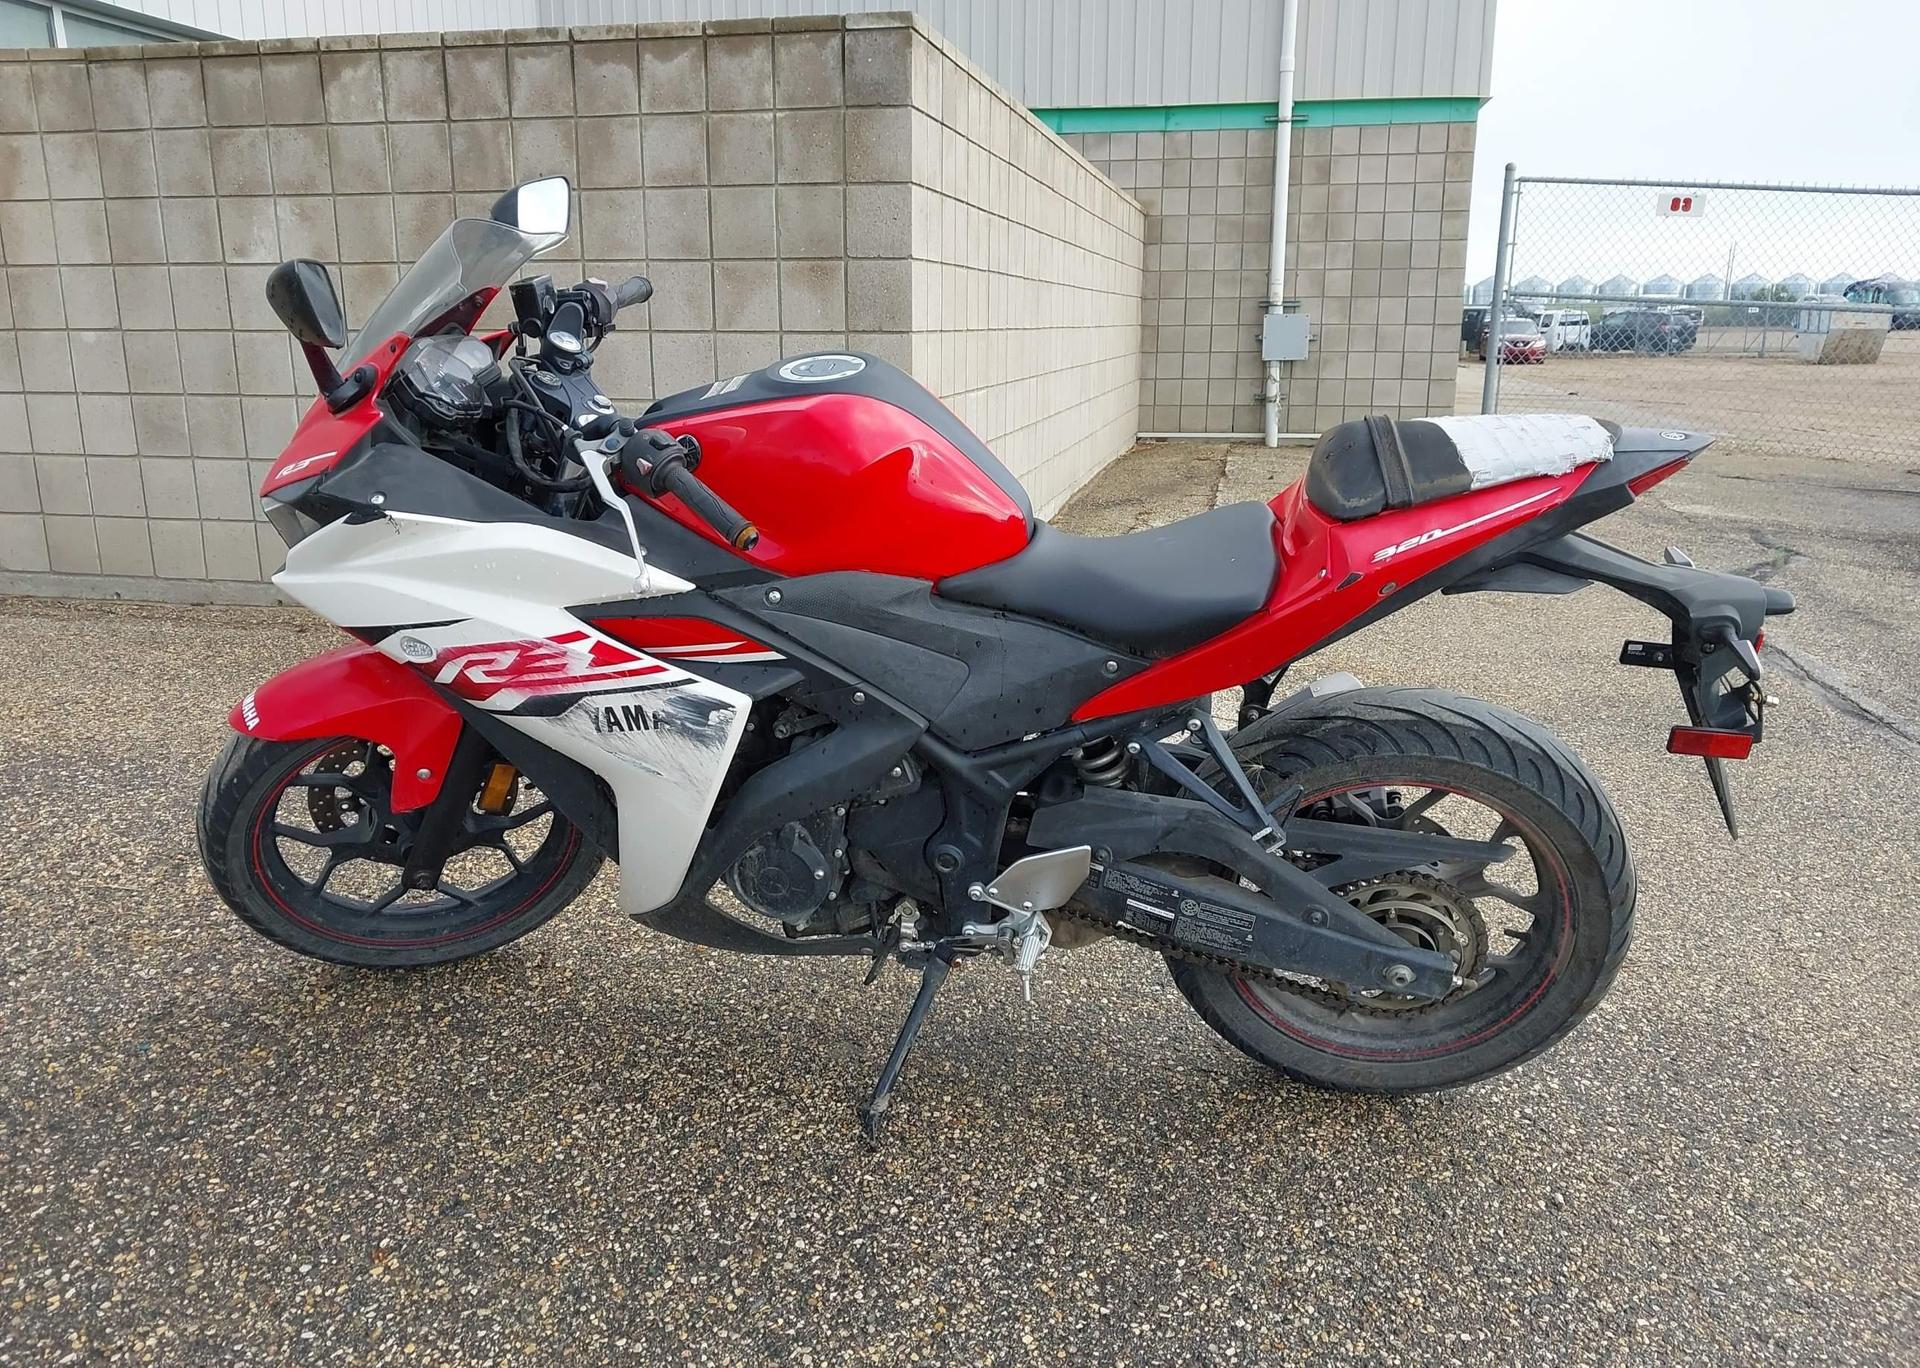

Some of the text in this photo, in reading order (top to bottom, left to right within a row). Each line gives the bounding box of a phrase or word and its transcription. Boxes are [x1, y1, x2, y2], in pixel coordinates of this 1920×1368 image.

[275, 457, 316, 480] R3
[1371, 528, 1443, 563] 320
[434, 645, 592, 684] R3
